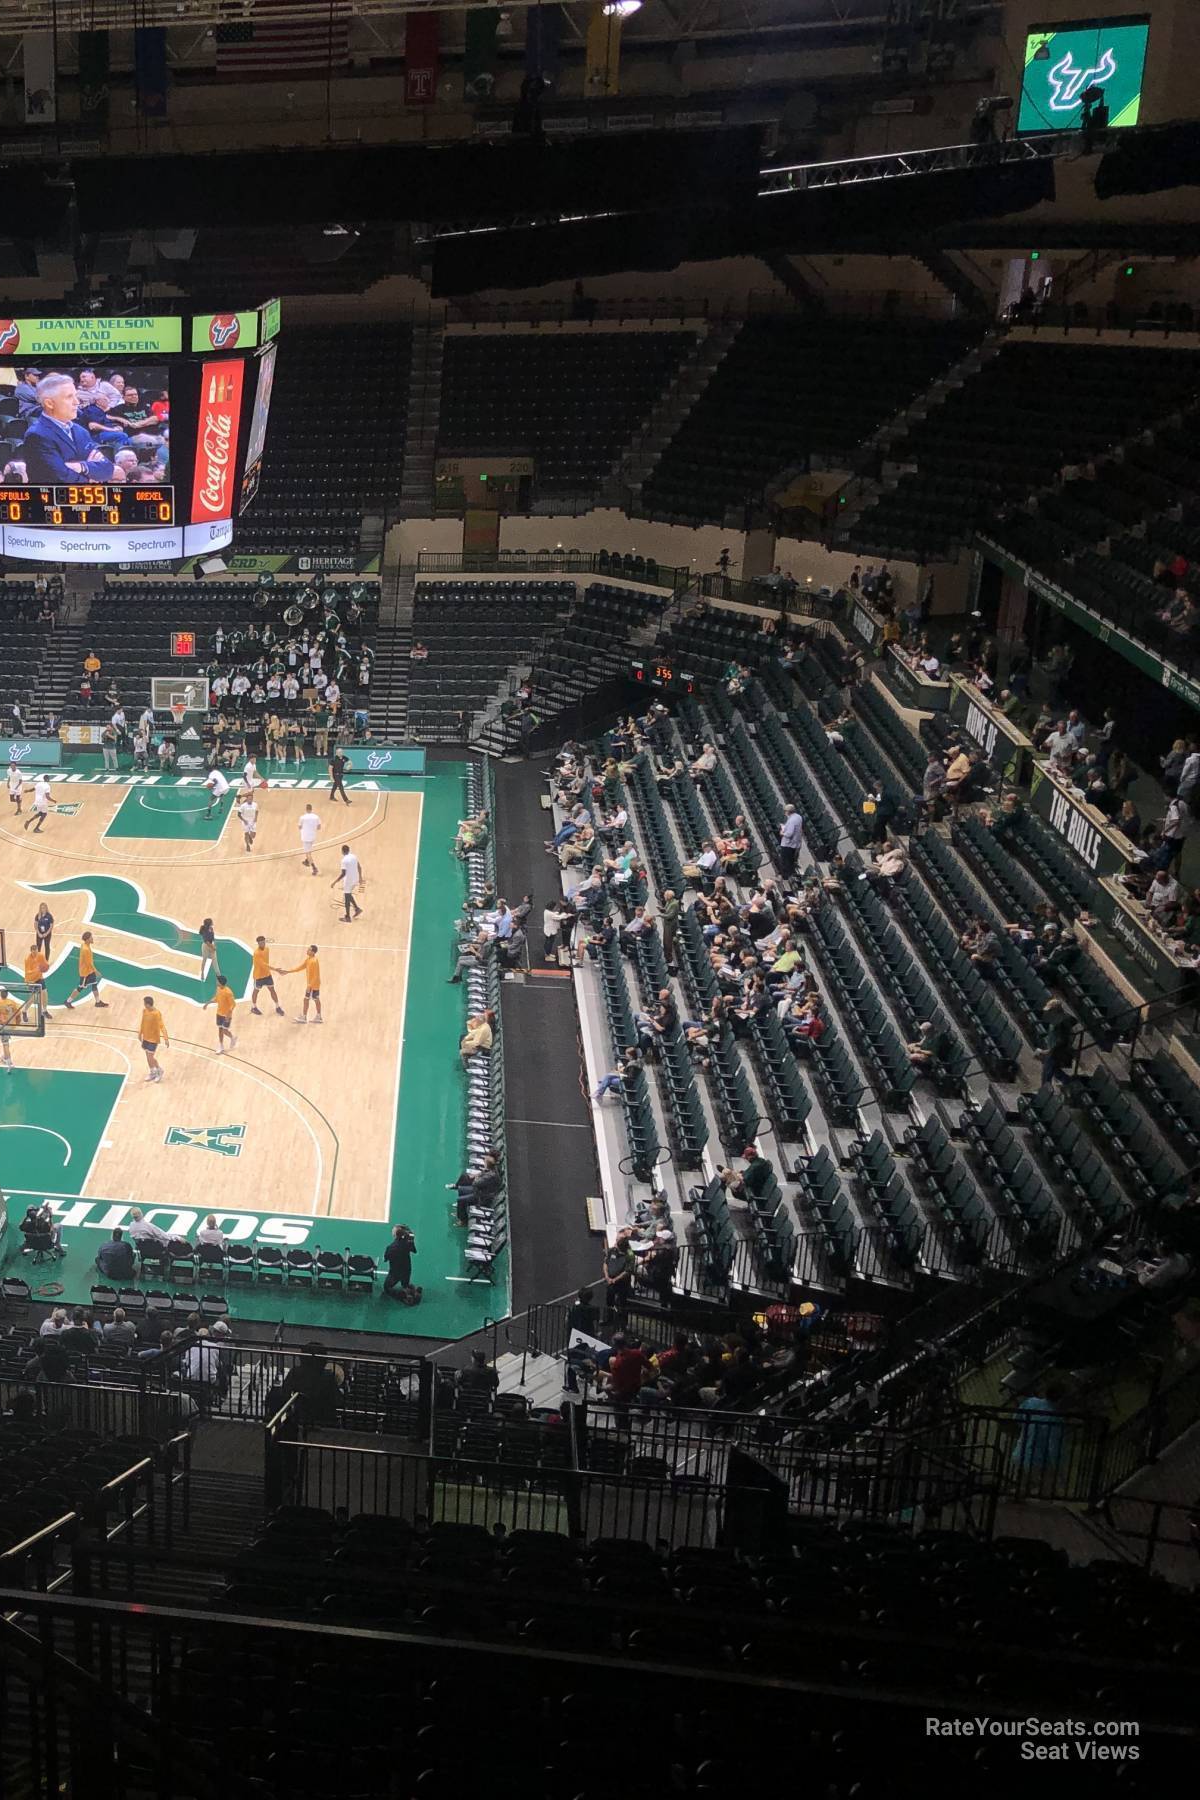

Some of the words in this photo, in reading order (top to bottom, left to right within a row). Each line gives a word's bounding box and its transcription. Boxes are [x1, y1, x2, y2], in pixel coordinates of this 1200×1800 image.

[37, 320, 94, 330] JOANNE
[97, 319, 155, 329] NELSON
[80, 331, 111, 340] AND
[32, 342, 76, 352] DAVID
[80, 341, 160, 351] GOLDSTEIN
[69, 487, 105, 504] 3:55
[10, 503, 20, 520] 0
[53, 511, 62, 524] 0
[110, 511, 119, 524] 0
[159, 503, 170, 521] 0
[7, 535, 42, 548] Spectrum
[60, 541, 108, 551] Spectrum
[128, 540, 173, 551] Spectrum
[229, 558, 257, 569] ERD
[1049, 788, 1071, 835] THE
[1067, 809, 1102, 870] BULLS
